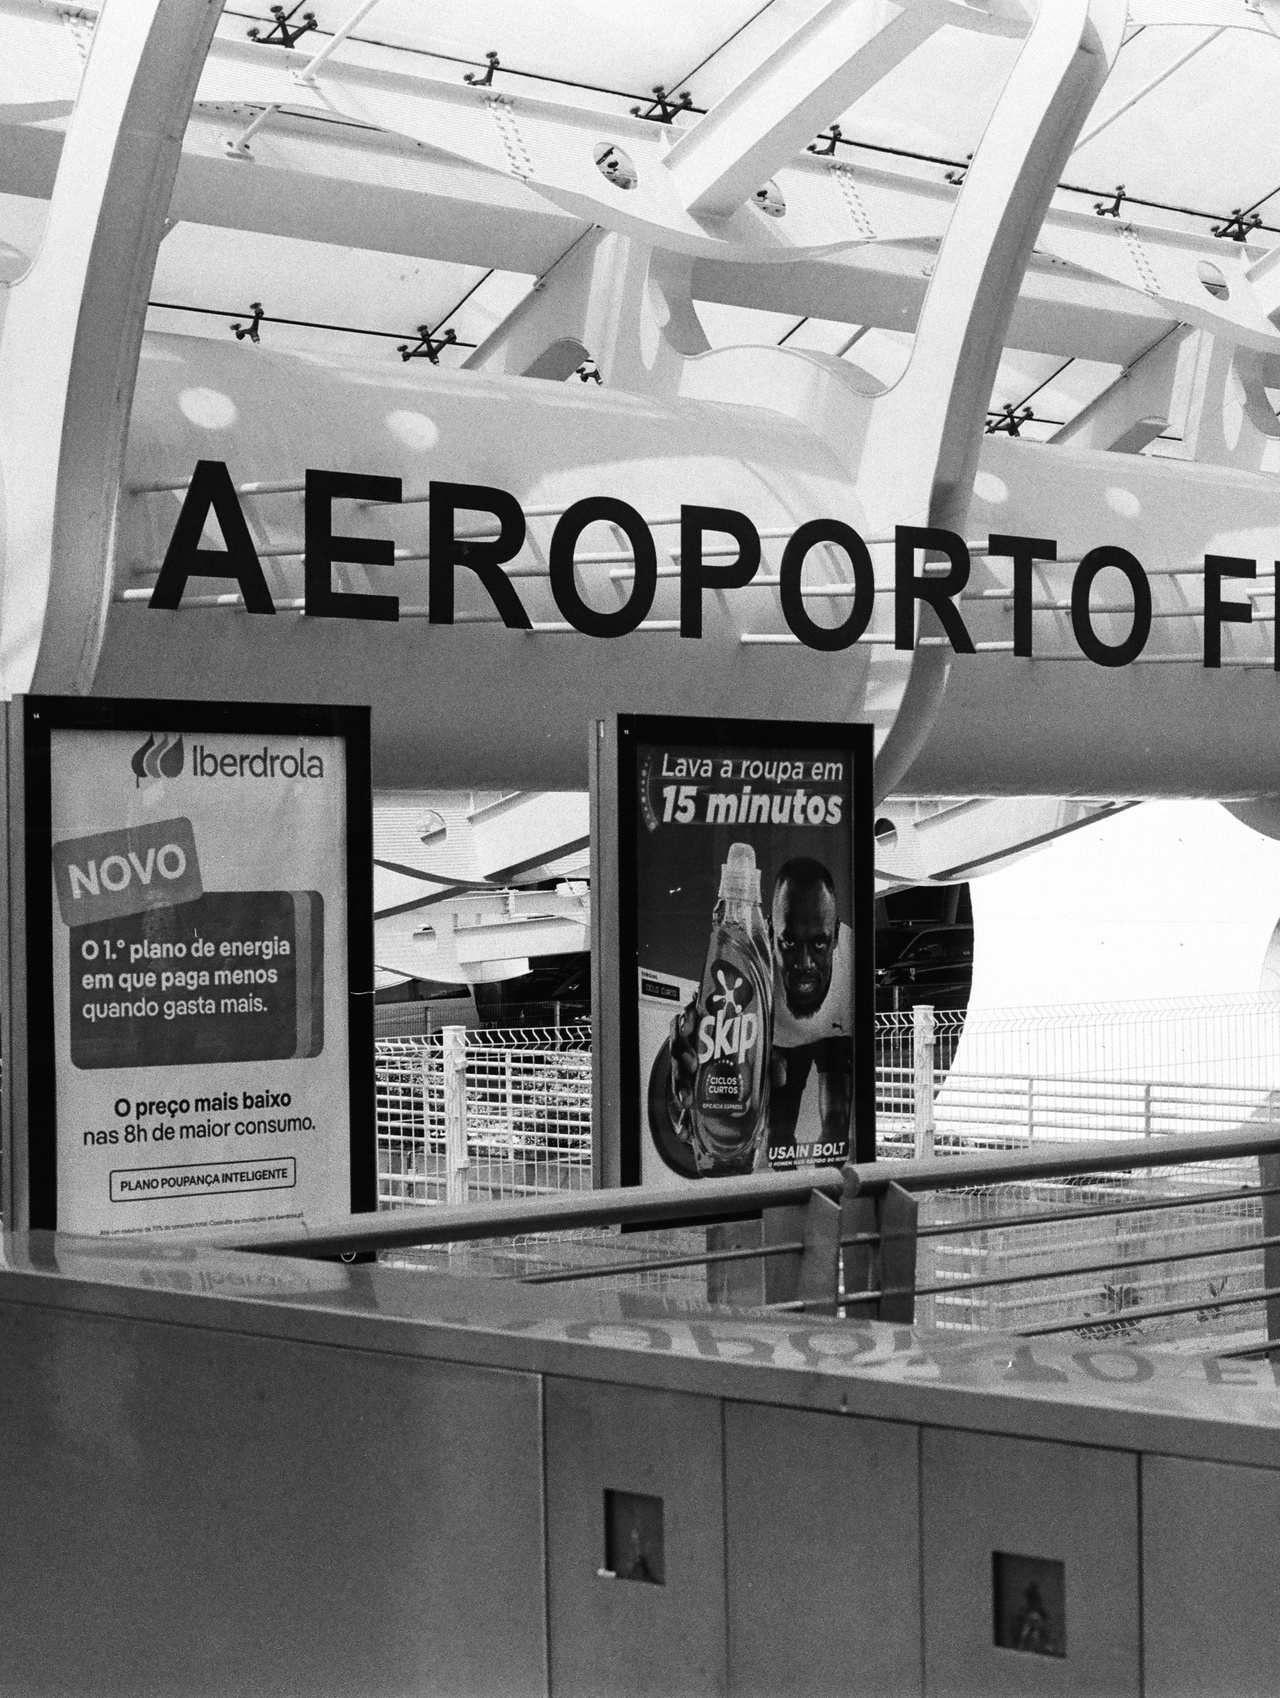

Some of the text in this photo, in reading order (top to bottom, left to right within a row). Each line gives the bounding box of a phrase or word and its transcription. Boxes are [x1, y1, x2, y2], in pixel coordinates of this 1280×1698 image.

[148, 459, 1152, 667] AEROPORTO
[192, 744, 324, 779] Iberdrola
[661, 753, 844, 784] Lava a roupa em
[662, 785, 843, 825] 15 minutos
[68, 844, 186, 899] NOVO
[81, 939, 99, 960] O
[130, 939, 187, 964] plano
[190, 938, 215, 957] de
[219, 935, 290, 960] energia
[81, 968, 278, 992] em que paga menos
[82, 993, 268, 1023] quando gasta mais.
[708, 1086, 738, 1095] CURTOS
[710, 1076, 737, 1085] CICLOS
[114, 1089, 292, 1120] O preço mais baixo
[83, 1116, 316, 1146] nas 8h de maior consumo.
[768, 1141, 845, 1160] USAIN BOLT
[120, 1167, 288, 1192] PLANO POUPANÇA INTELIGENTE
